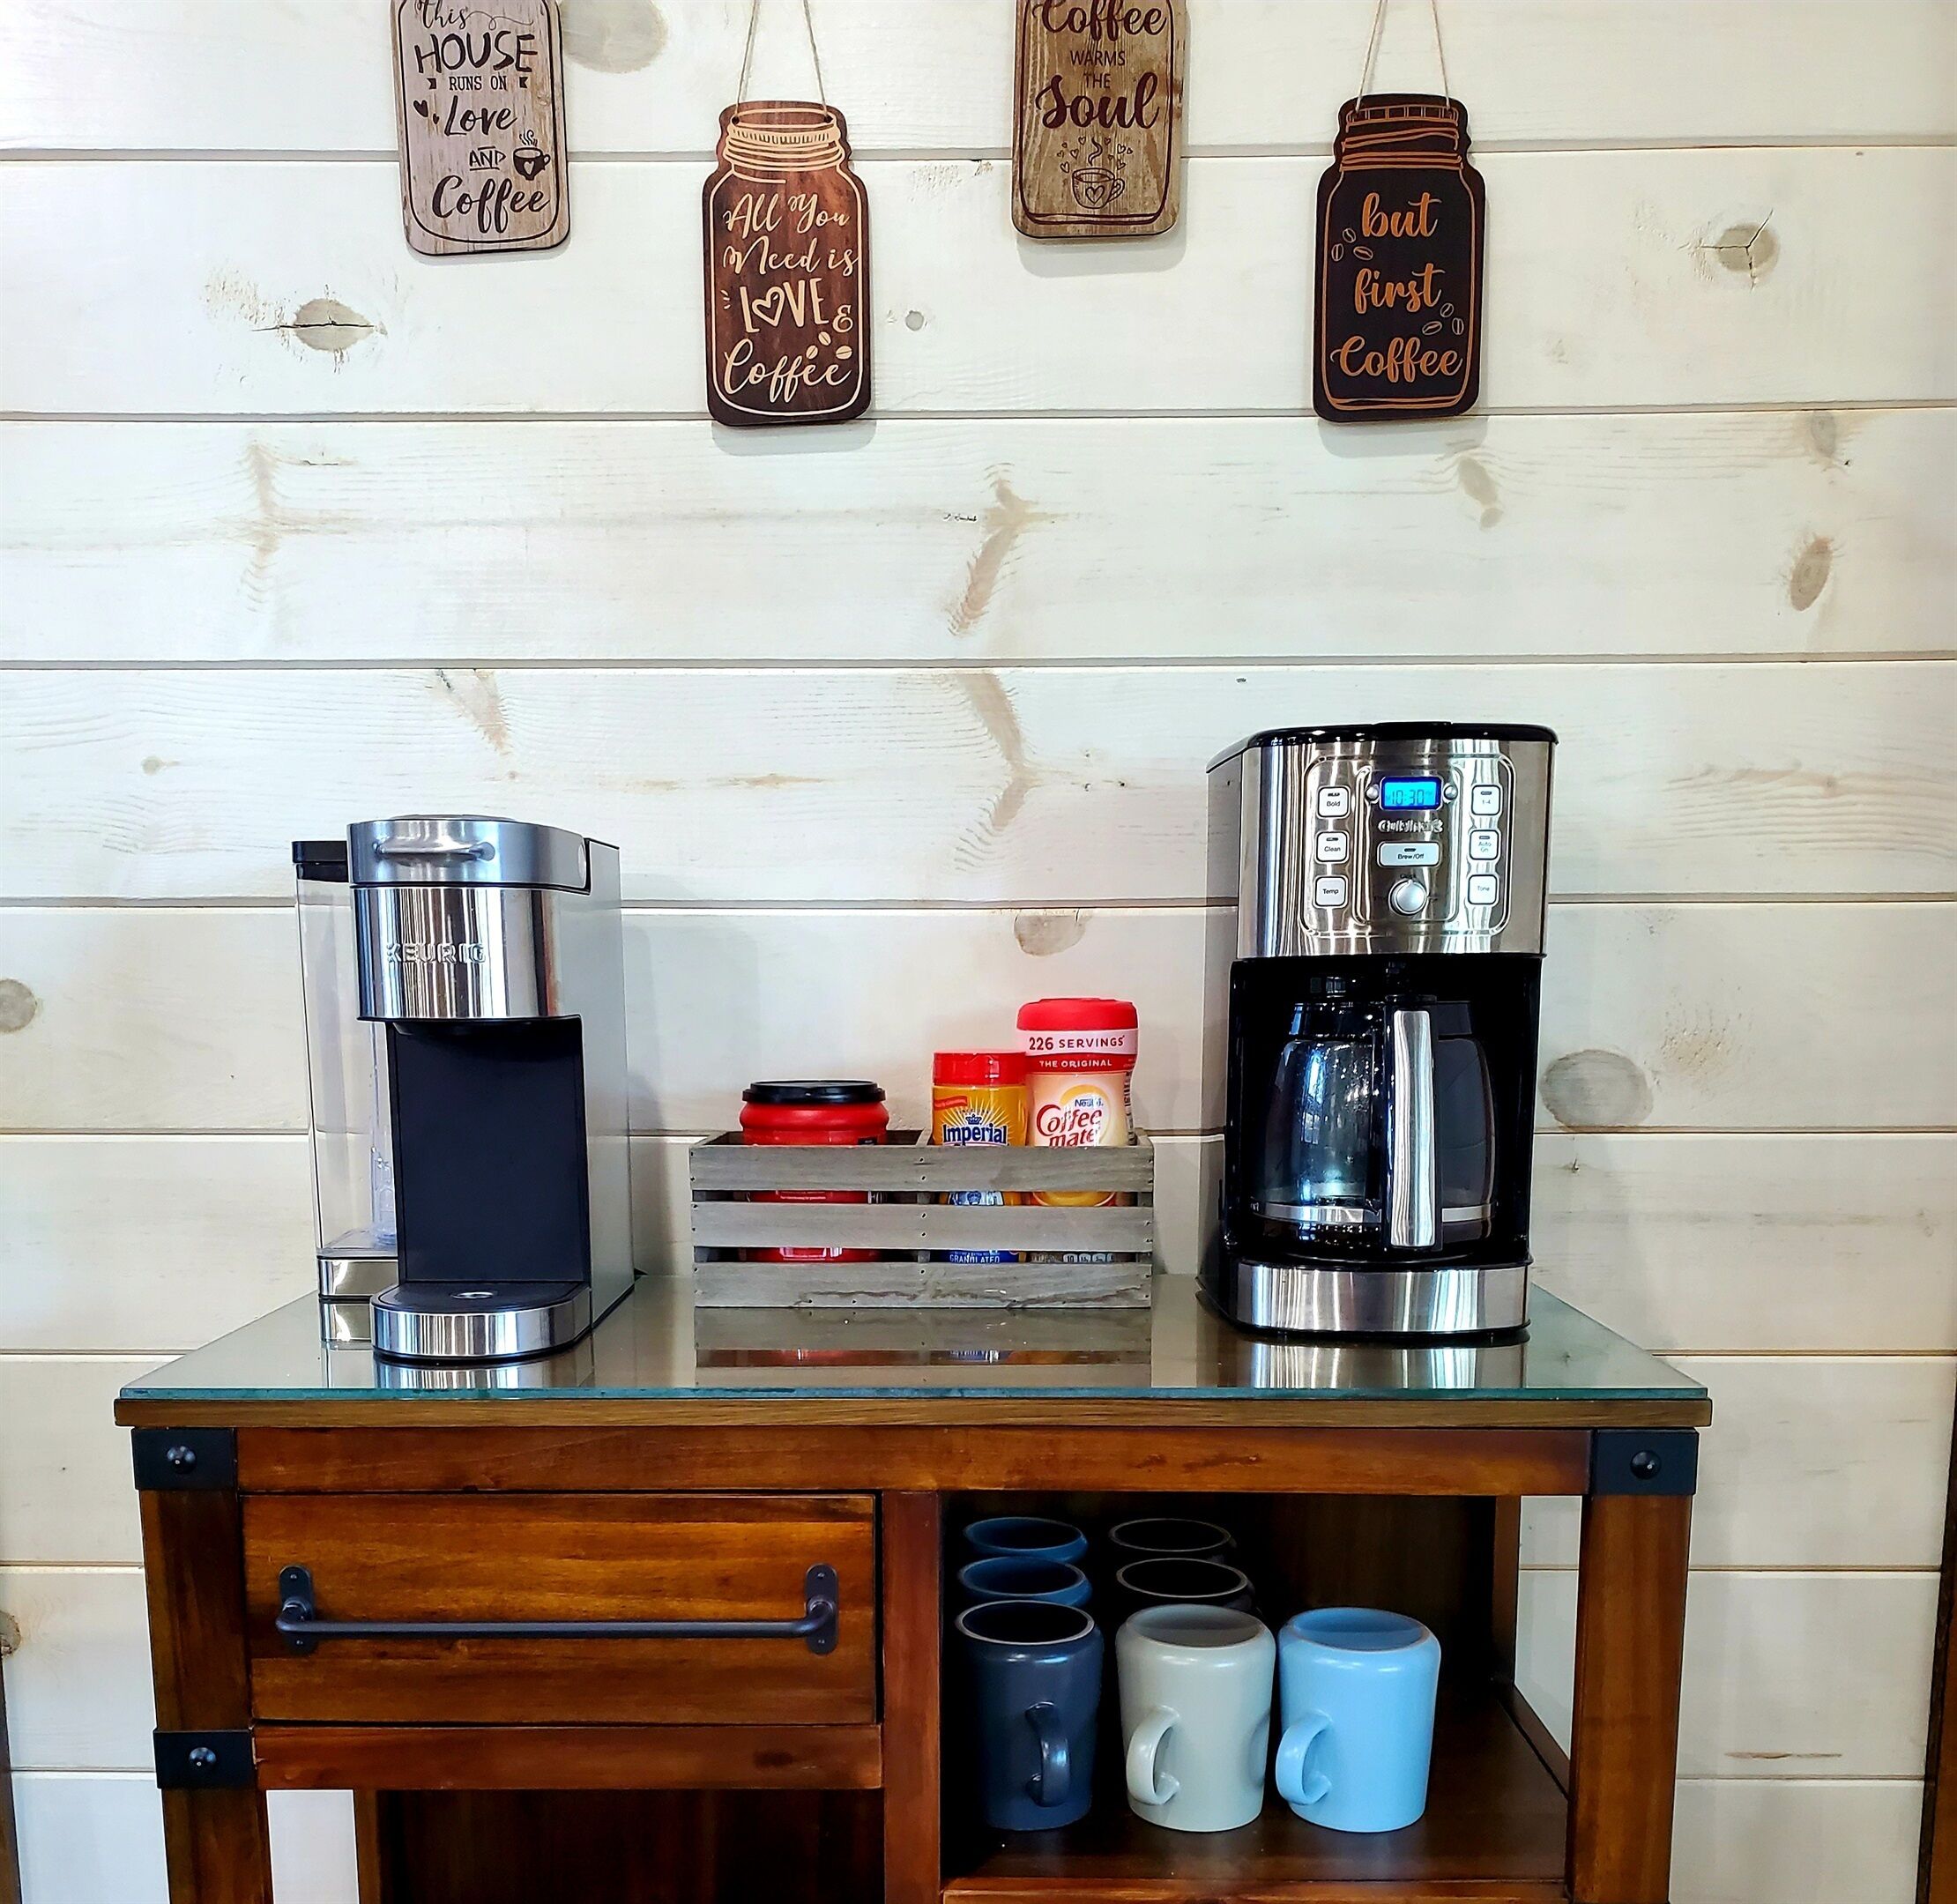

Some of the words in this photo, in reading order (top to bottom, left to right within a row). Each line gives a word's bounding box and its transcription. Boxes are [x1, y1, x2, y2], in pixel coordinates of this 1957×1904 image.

[1032, 0, 1167, 41] Coffee
[414, 31, 538, 73] HOUSE
[1070, 50, 1127, 66] WARMS
[449, 76, 482, 91] RUNS
[490, 75, 507, 91] ON
[1035, 71, 1161, 129] Soul
[1083, 72, 1111, 89] THE
[443, 95, 517, 137] Love
[469, 147, 506, 168] AND
[432, 175, 551, 234] Coffee
[723, 193, 783, 240] All
[788, 193, 851, 234] You
[1361, 191, 1442, 238] but
[723, 235, 822, 275] Need
[828, 248, 859, 278] is
[1354, 263, 1446, 314] first
[832, 305, 854, 333] &
[724, 338, 852, 403] Coffee
[1330, 335, 1463, 383] Coffee
[386, 942, 487, 963] KEURIG
[1029, 1037, 1054, 1051] 226
[1038, 1060, 1059, 1068] THE
[1060, 1059, 1112, 1068] ORIGINAL
[942, 1123, 1008, 1146] Imperial
[1036, 1104, 1103, 1137] Coffee
